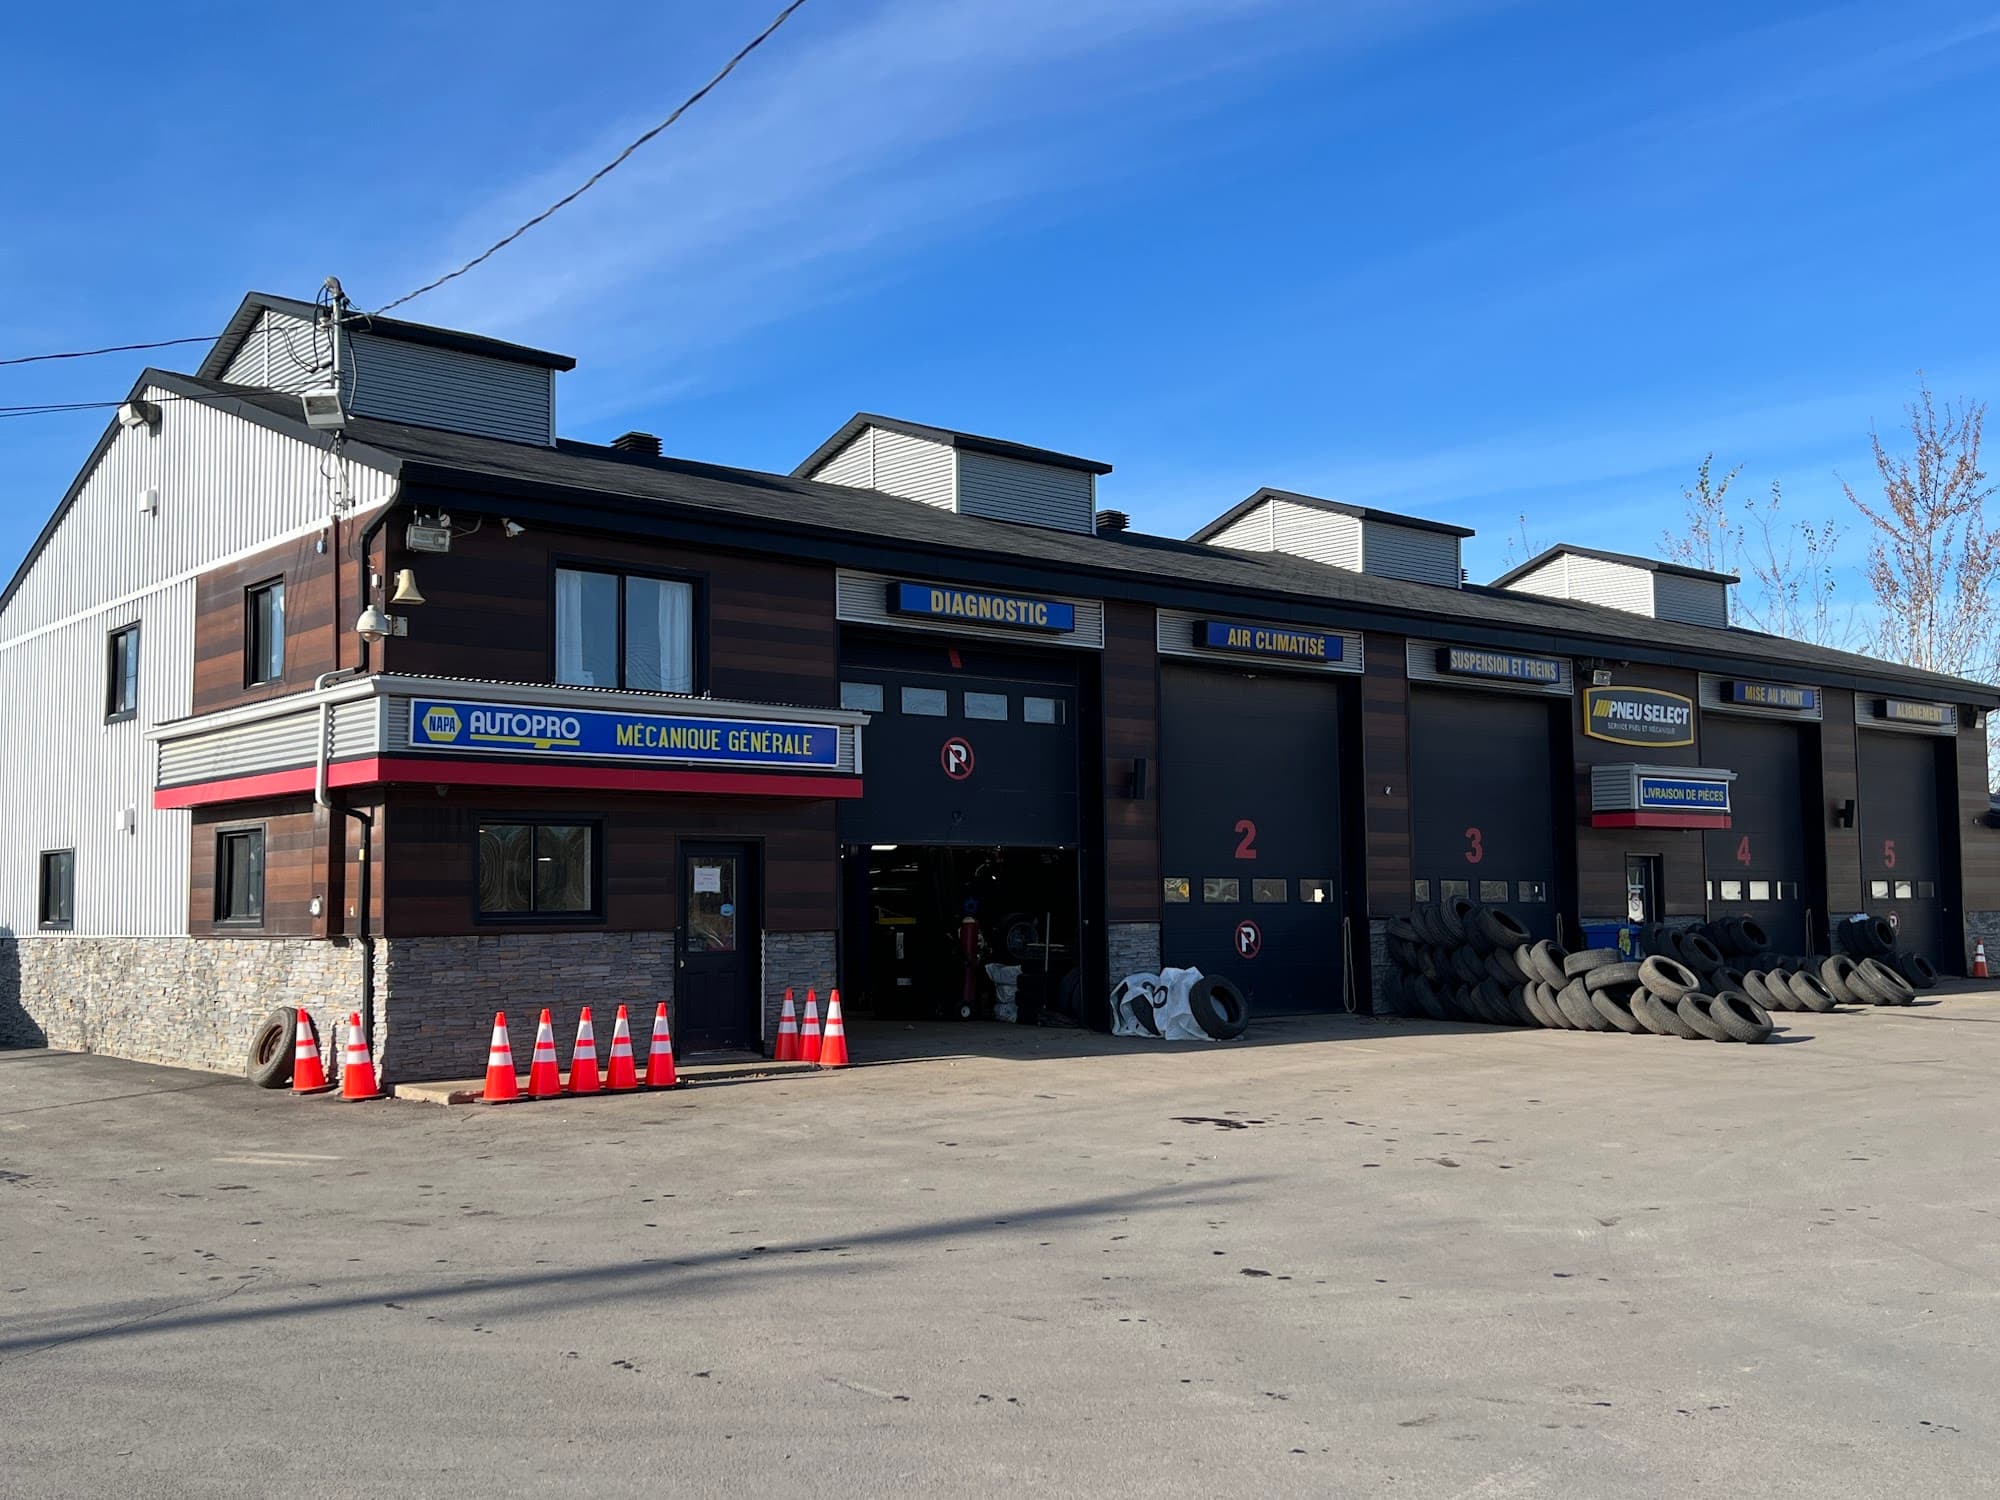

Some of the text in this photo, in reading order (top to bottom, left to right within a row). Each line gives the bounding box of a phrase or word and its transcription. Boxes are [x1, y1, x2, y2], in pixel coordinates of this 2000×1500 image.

[930, 590, 1048, 625] DIAGNOSTIC
[1228, 628, 1325, 656] AIR CLIMATISÉ
[1451, 650, 1556, 680] SUSPENSION ET FREINS
[1745, 686, 1803, 706] MISE AU POINT
[429, 711, 581, 739] NAPA AUTOPRO
[616, 722, 813, 755] MÉCANIQUE GÉNÉRALE
[1644, 787, 1684, 800] LIVRAISON
[1686, 789, 1696, 801] DE
[1234, 819, 1257, 859] 2
[1465, 827, 1483, 864] 3
[1737, 835, 1751, 866] 4
[1884, 839, 1896, 868] 5
